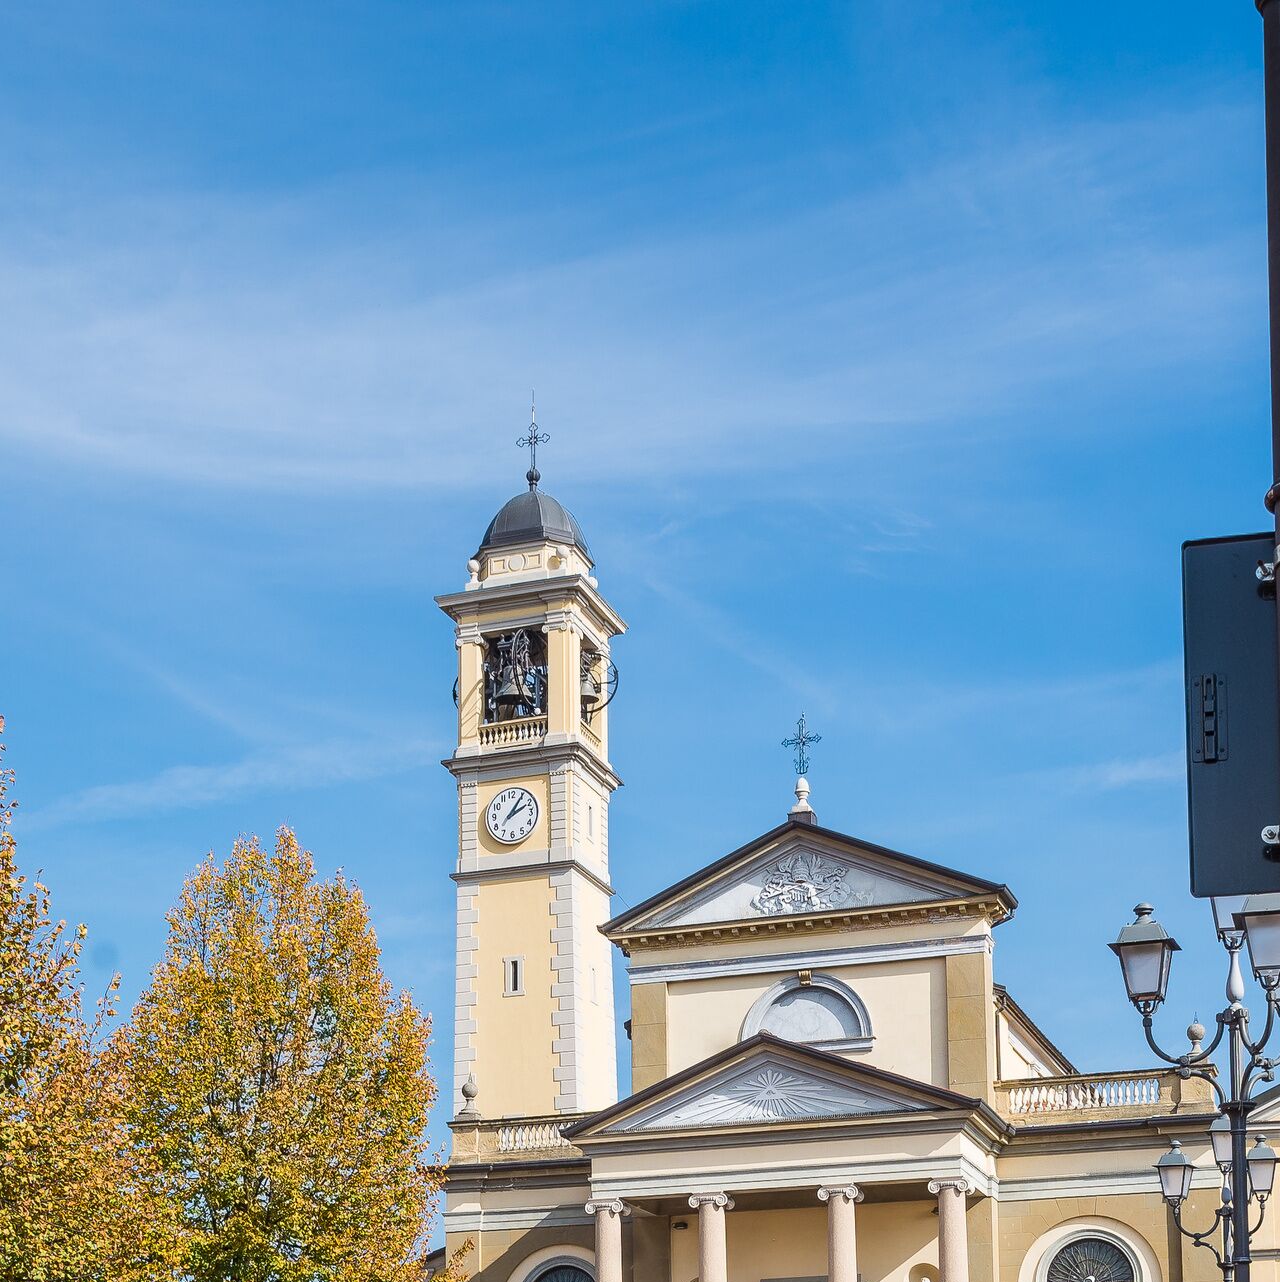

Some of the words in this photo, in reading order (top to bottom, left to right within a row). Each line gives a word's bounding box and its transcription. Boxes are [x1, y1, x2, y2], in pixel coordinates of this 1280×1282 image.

[501, 795, 506, 803] 11
[508, 791, 516, 799] 12
[527, 798, 532, 806] 2
[493, 802, 501, 811] 10
[529, 807, 533, 816] 3
[527, 818, 532, 827] 4
[494, 823, 499, 831] 8
[520, 827, 525, 835] 5
[510, 831, 515, 839] 6
